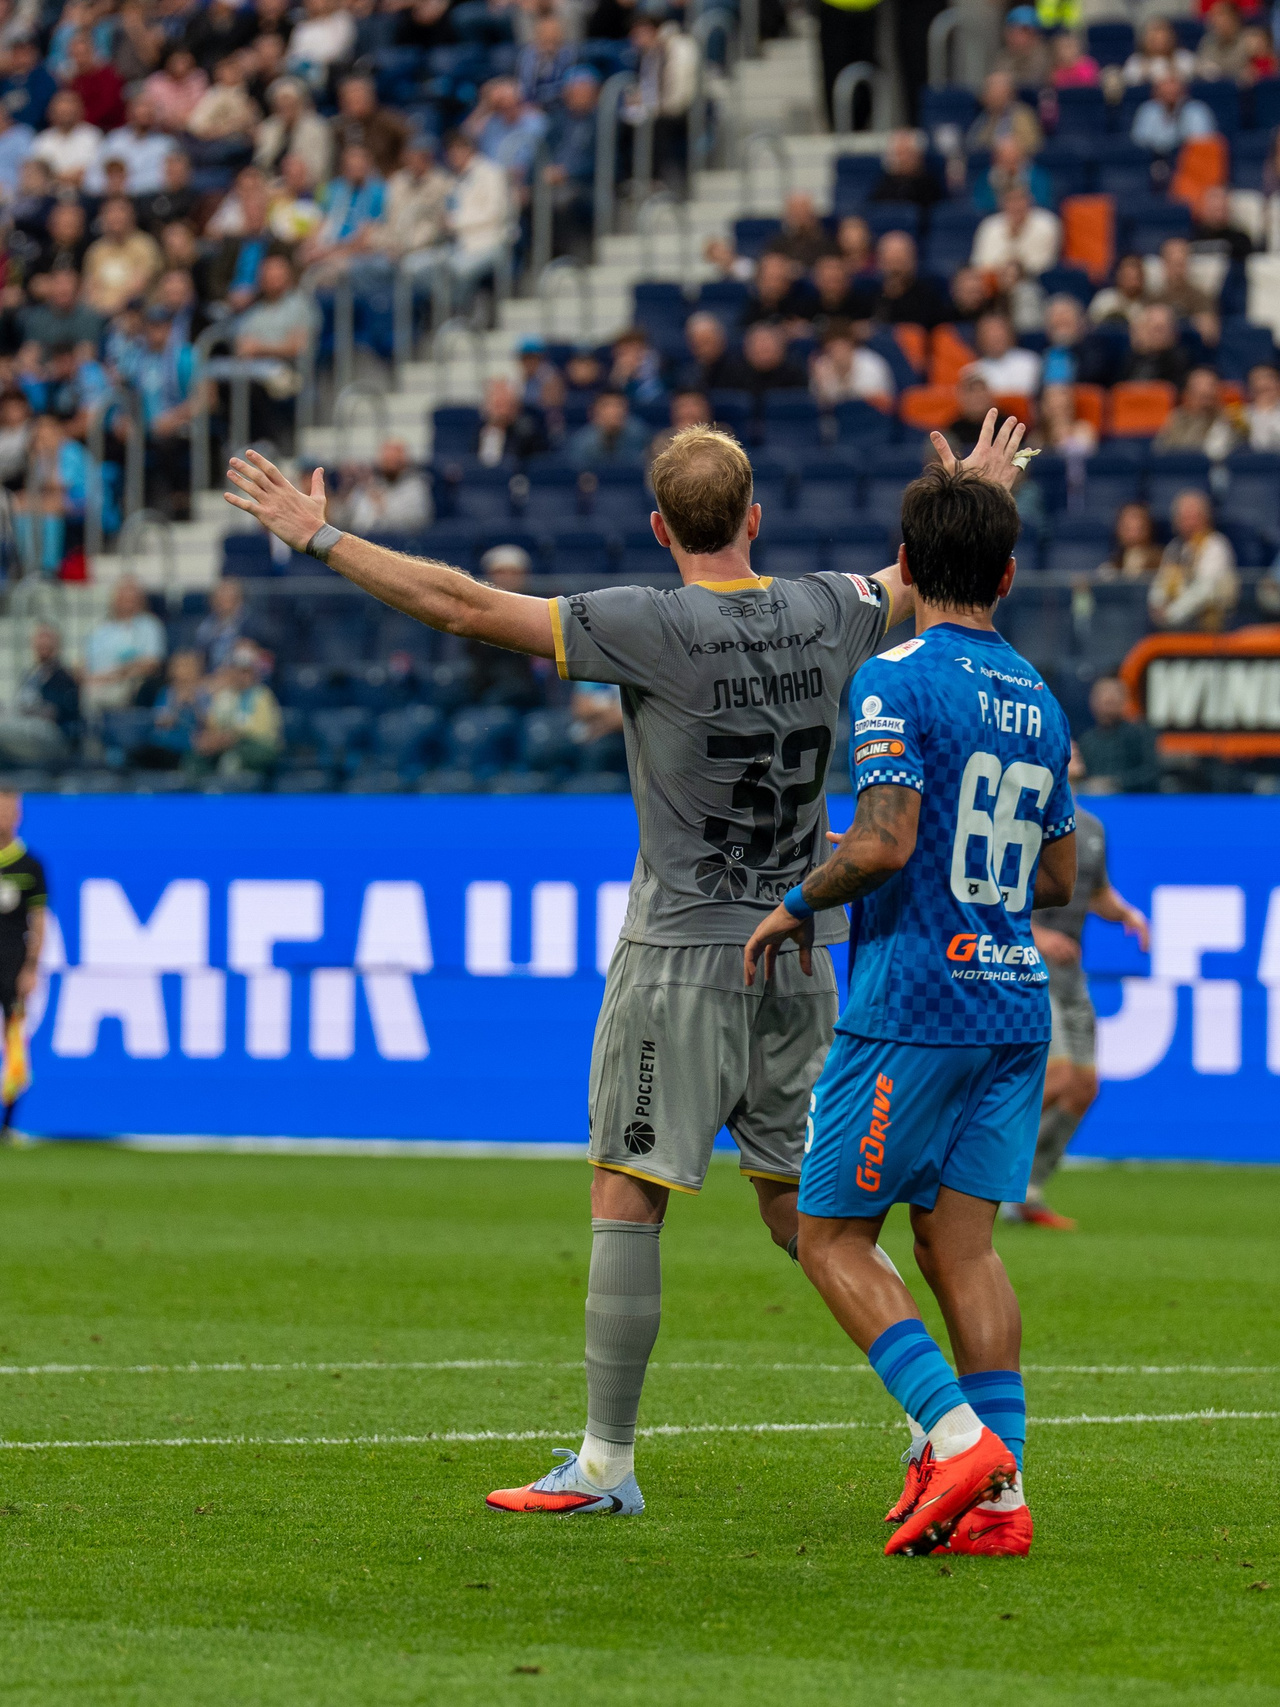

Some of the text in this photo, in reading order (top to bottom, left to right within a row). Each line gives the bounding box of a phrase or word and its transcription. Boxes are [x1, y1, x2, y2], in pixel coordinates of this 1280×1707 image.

[713, 667, 822, 711] ЛУСИАНО
[703, 725, 831, 868] 32
[950, 751, 1054, 912] 66
[635, 1040, 656, 1117] РОССЕТИ
